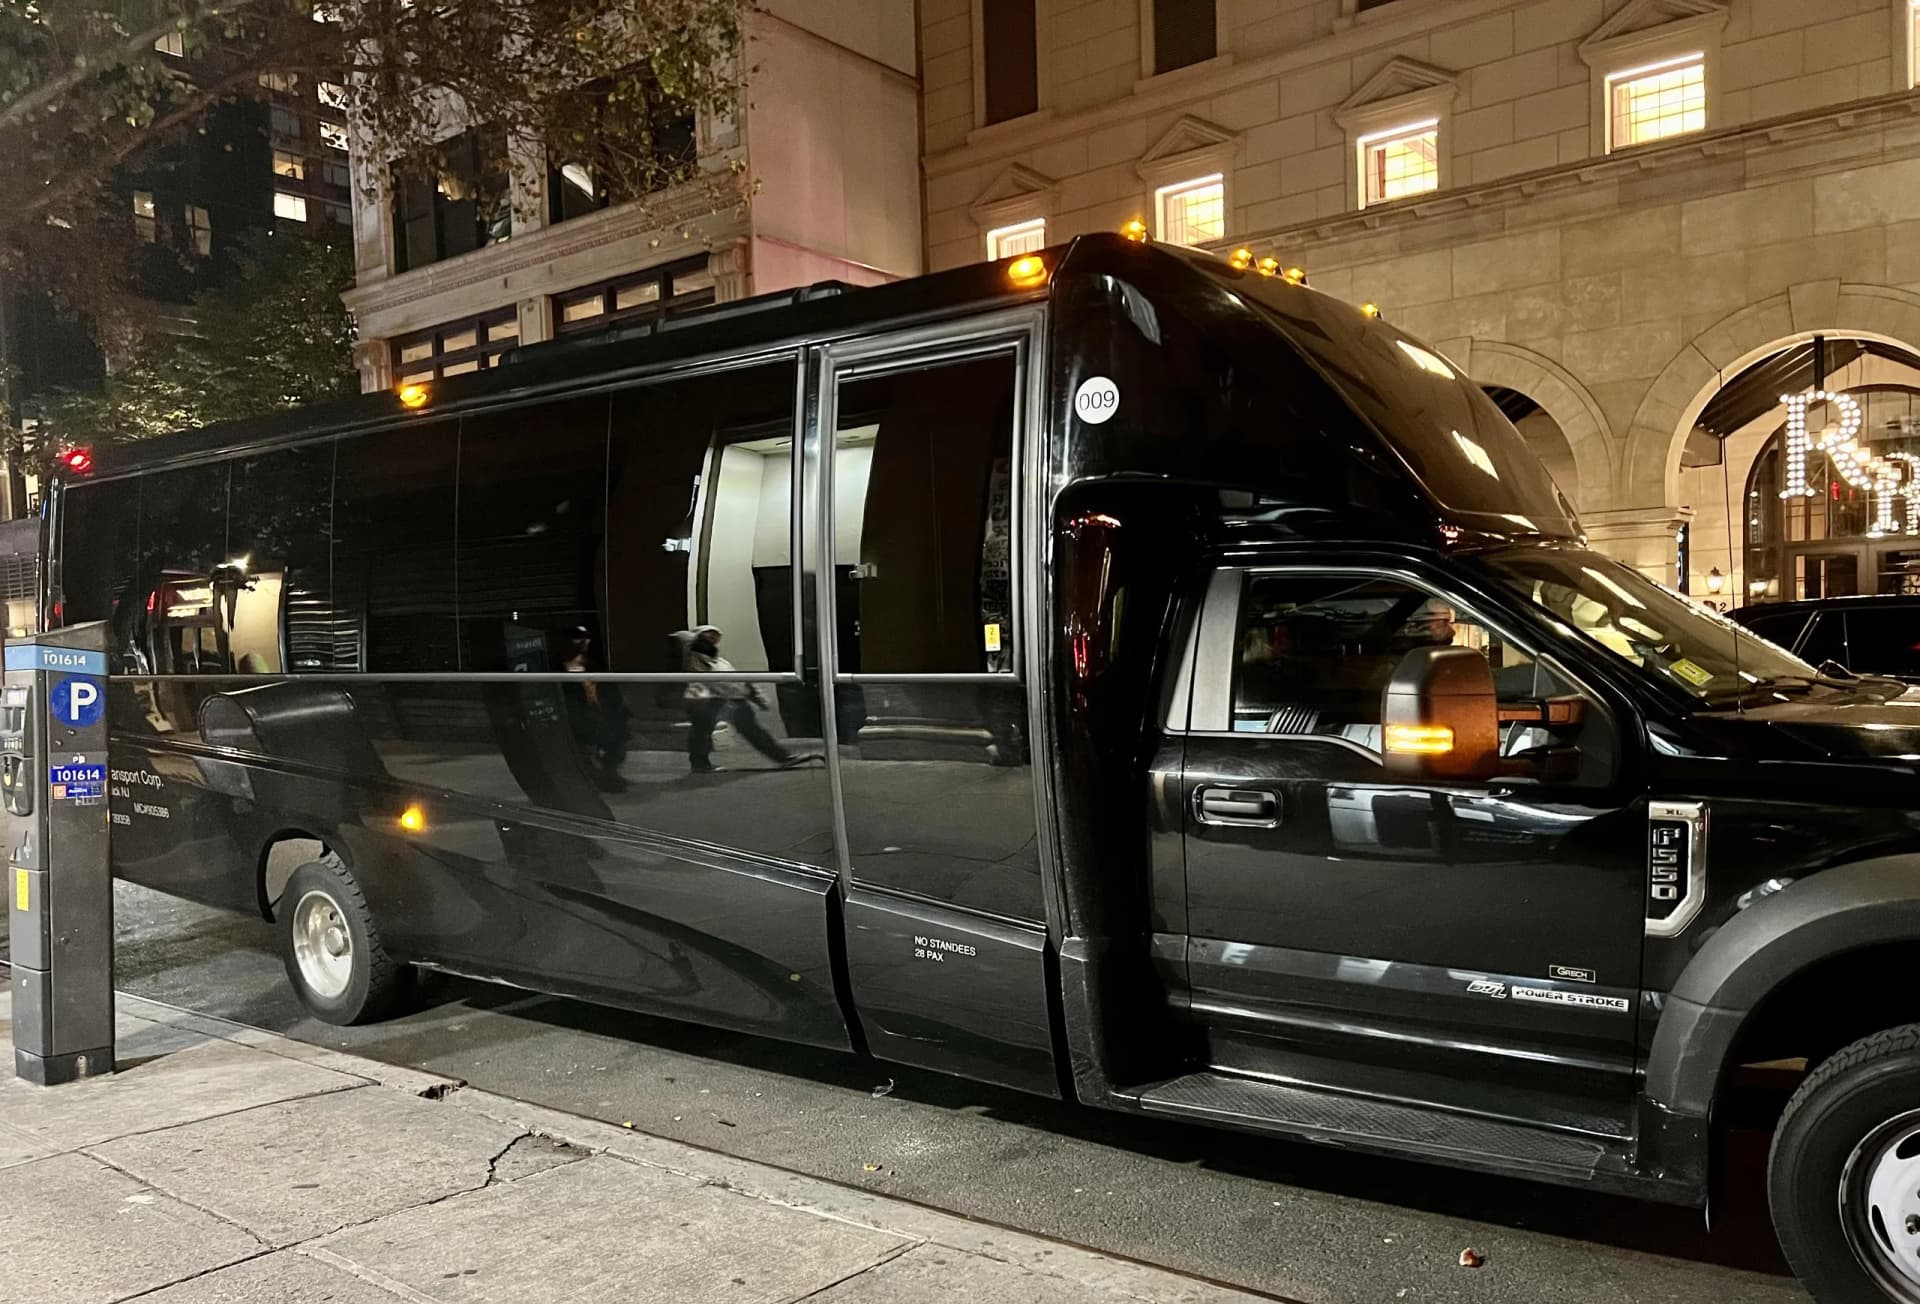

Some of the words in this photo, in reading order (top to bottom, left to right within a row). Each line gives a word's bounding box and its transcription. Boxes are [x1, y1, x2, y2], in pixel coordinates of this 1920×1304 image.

[1079, 390, 1115, 411] 009
[43, 654, 87, 666] 101614
[70, 681, 98, 721] P
[57, 769, 100, 781] 101614
[111, 769, 141, 785] ansport
[140, 769, 164, 790] Corp.
[1665, 808, 1684, 816] XL
[1651, 827, 1681, 900] F550
[914, 935, 928, 946] NO
[930, 939, 976, 956] STANDEES
[914, 948, 926, 958] 28
[926, 950, 944, 962] PAX
[1515, 989, 1564, 1001] POWER
[1567, 994, 1625, 1008] STROKE
